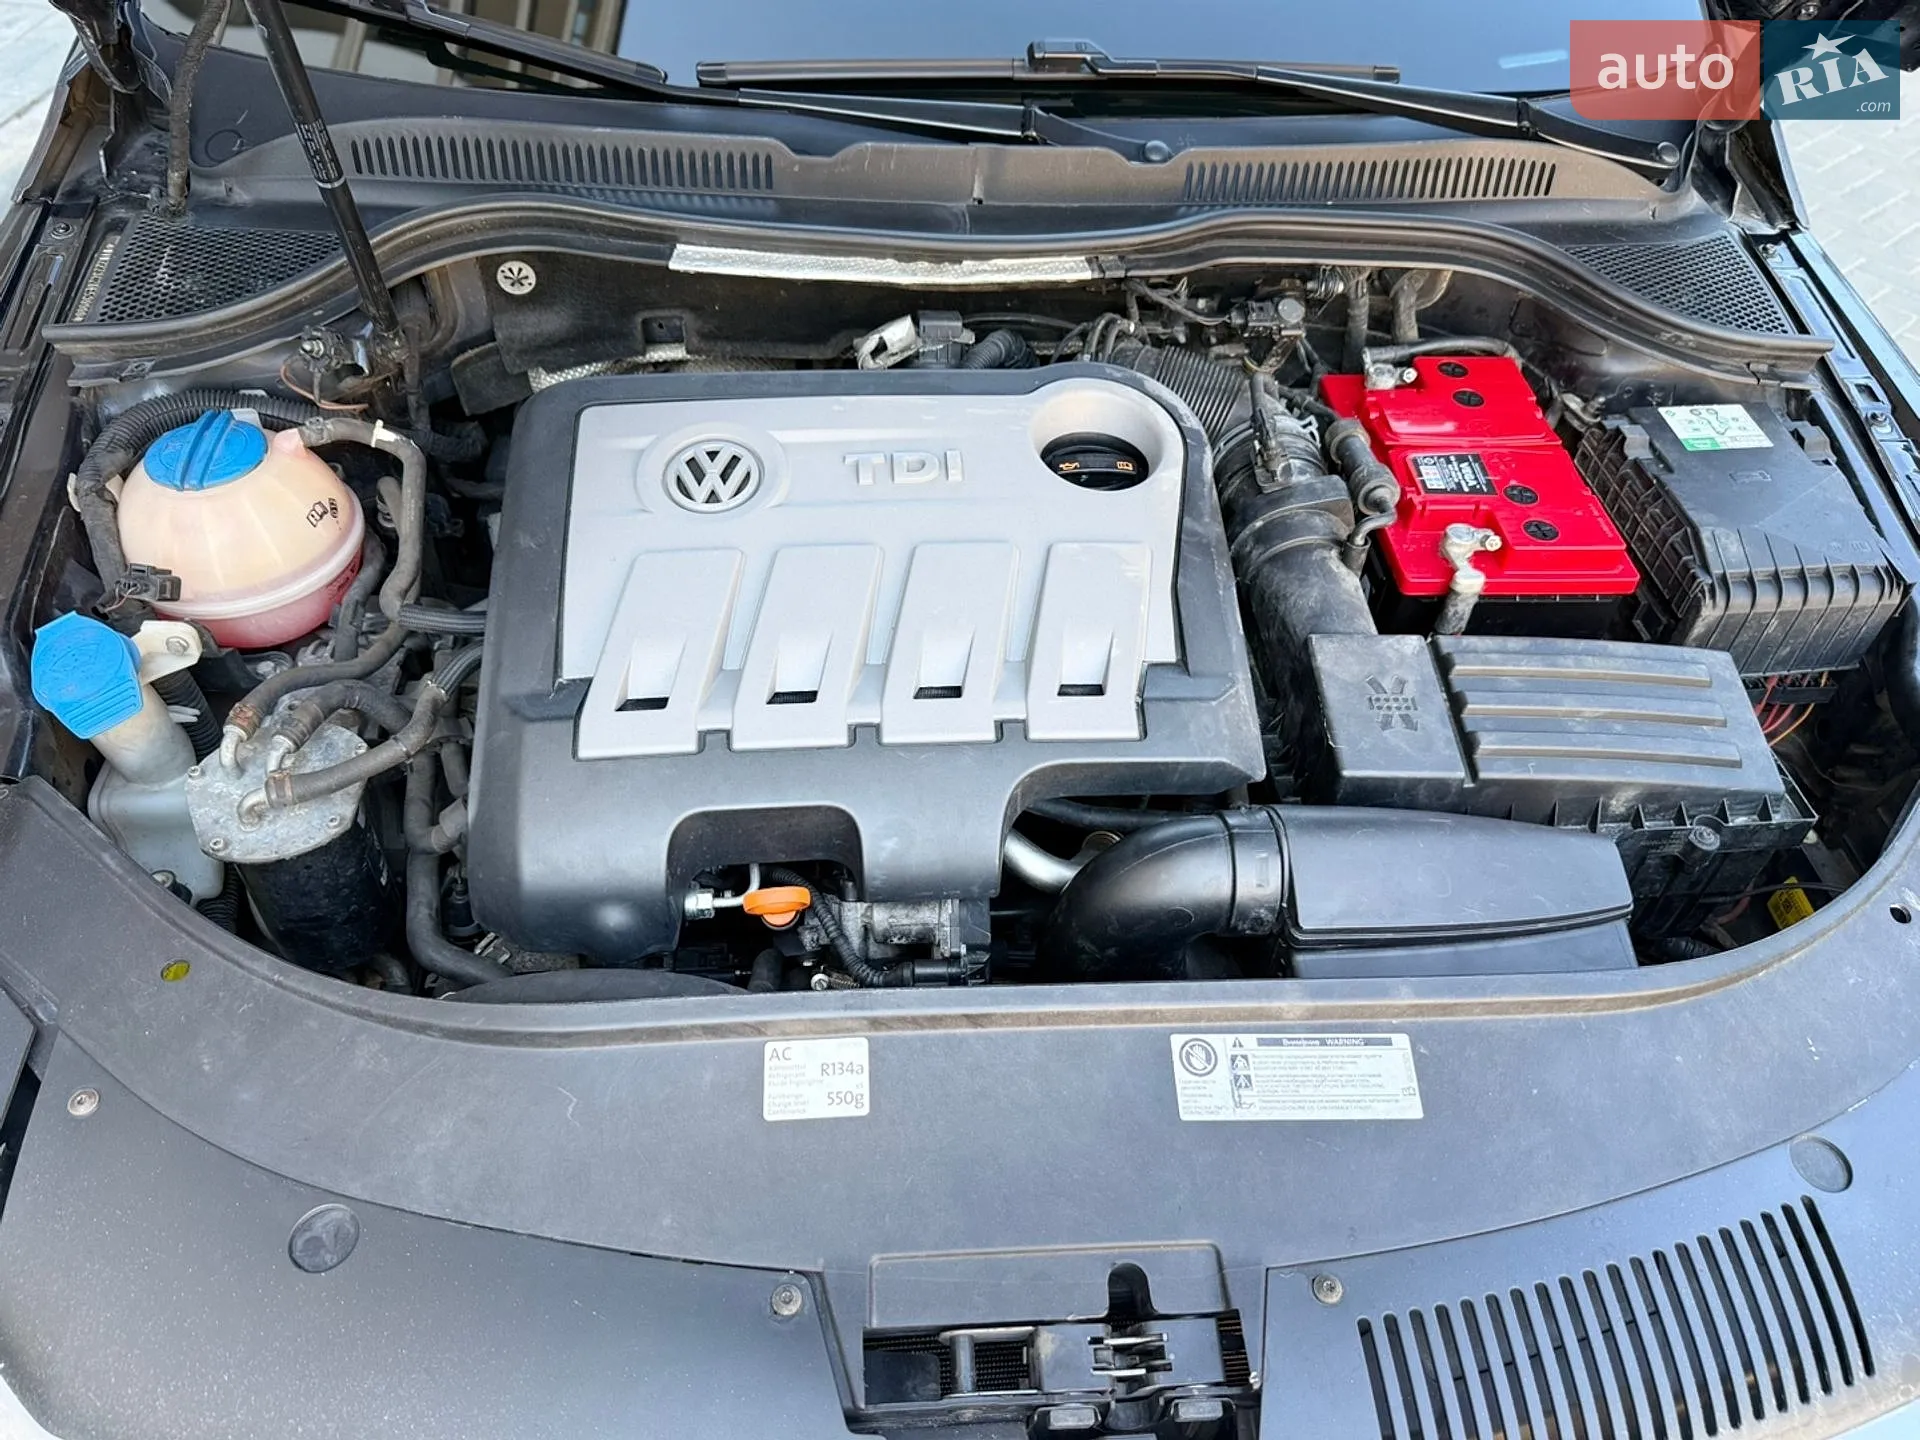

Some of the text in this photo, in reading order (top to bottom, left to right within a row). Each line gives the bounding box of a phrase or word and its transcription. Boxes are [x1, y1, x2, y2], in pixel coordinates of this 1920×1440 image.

[844, 449, 964, 486] TDI
[769, 1048, 792, 1061] AC
[821, 1062, 864, 1076] R134a
[827, 1090, 865, 1109] 550g
